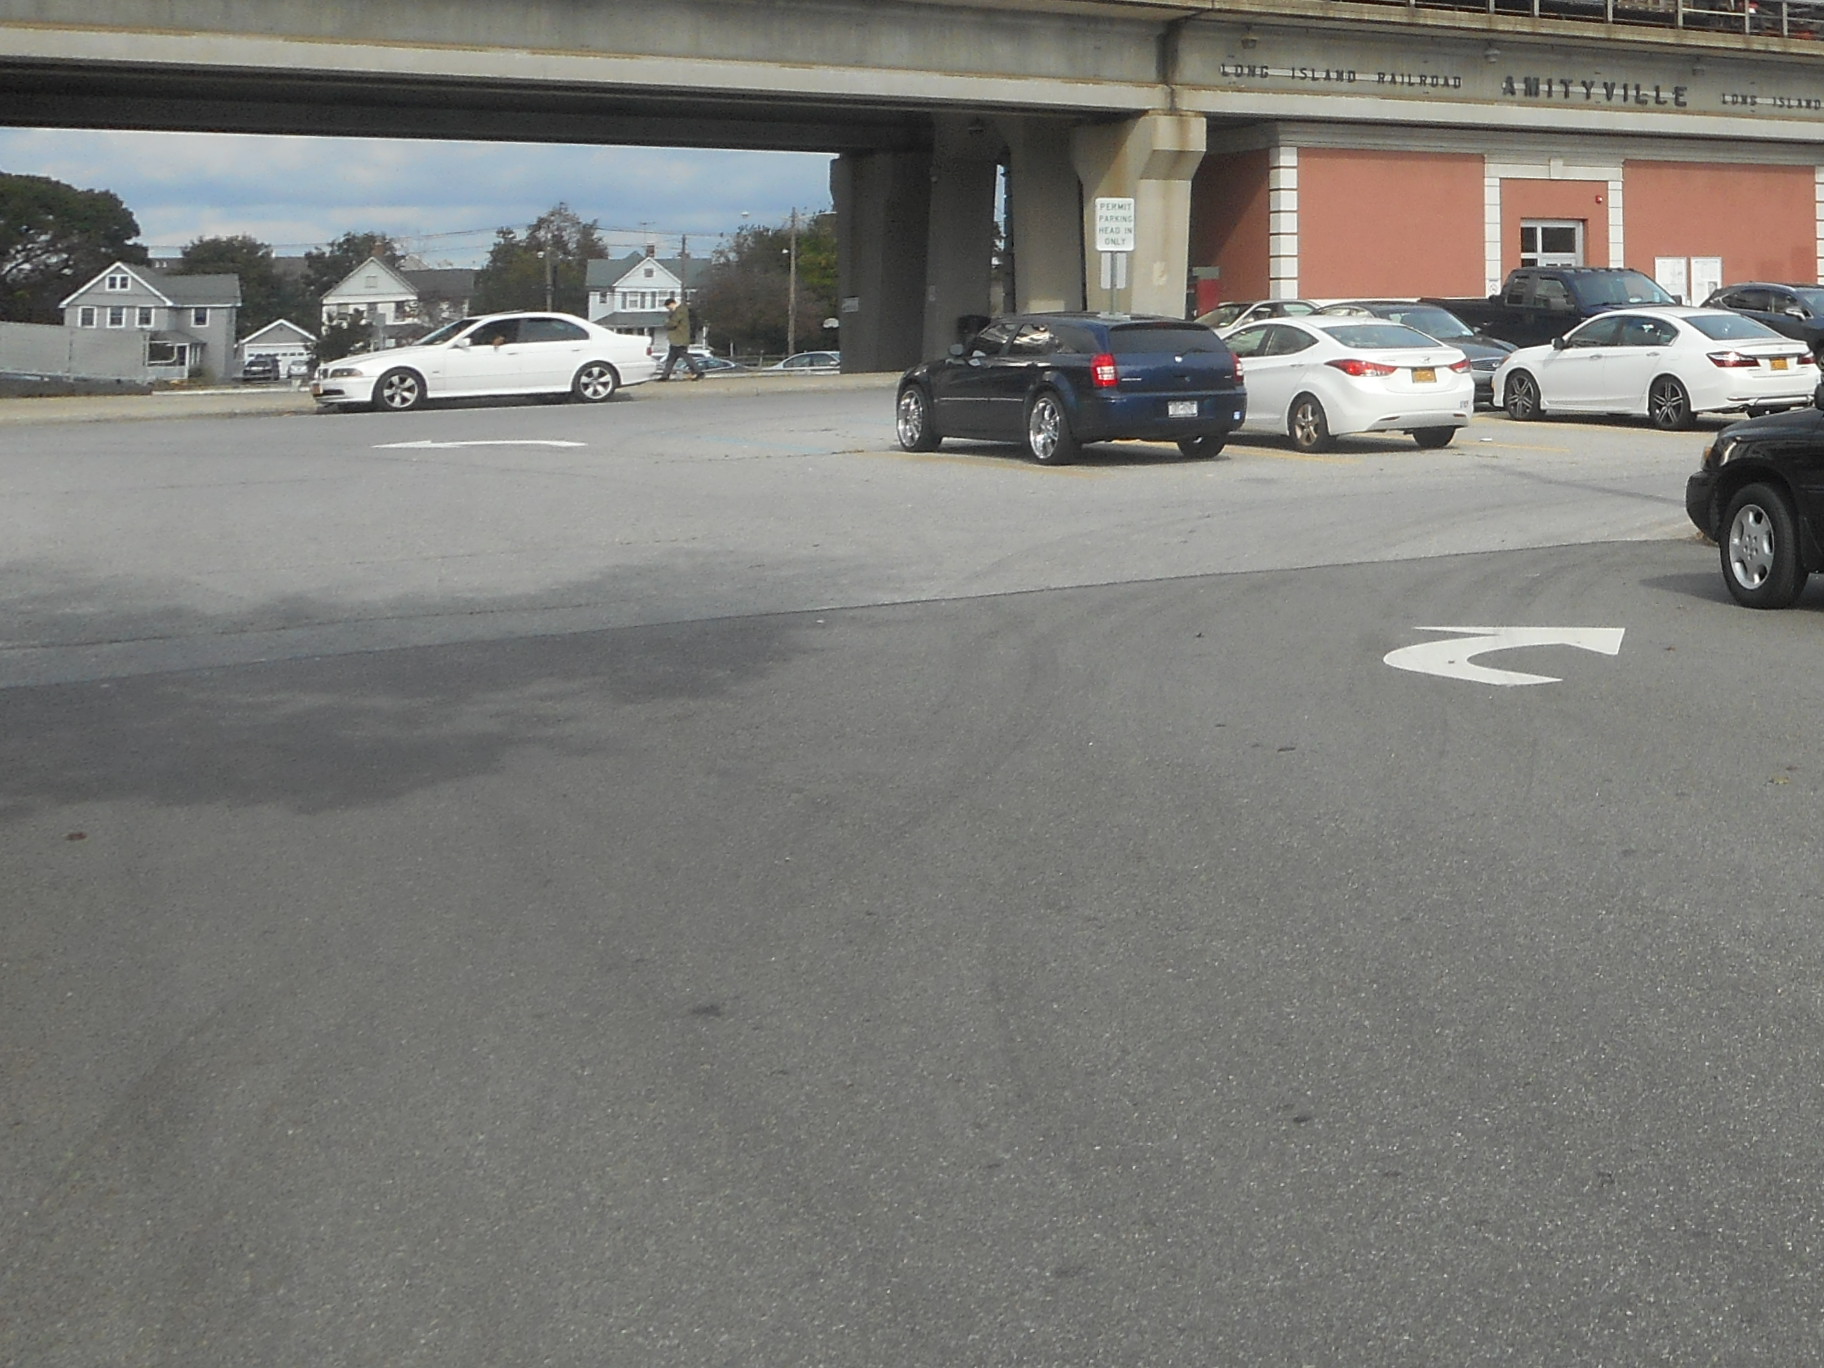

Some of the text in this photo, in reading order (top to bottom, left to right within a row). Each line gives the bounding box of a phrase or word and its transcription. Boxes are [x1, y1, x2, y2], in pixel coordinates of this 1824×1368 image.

[1220, 63, 1463, 89] LONG ISLAND RAILROAD
[1502, 75, 1688, 107] AMITYVILLE
[1721, 92, 1757, 106] LONG
[1772, 96, 1822, 111] ISLAND
[1100, 202, 1132, 210] PERMIT
[1098, 214, 1133, 223] PARKING
[1099, 226, 1121, 234] HEAD
[1104, 237, 1126, 245] ONLY
